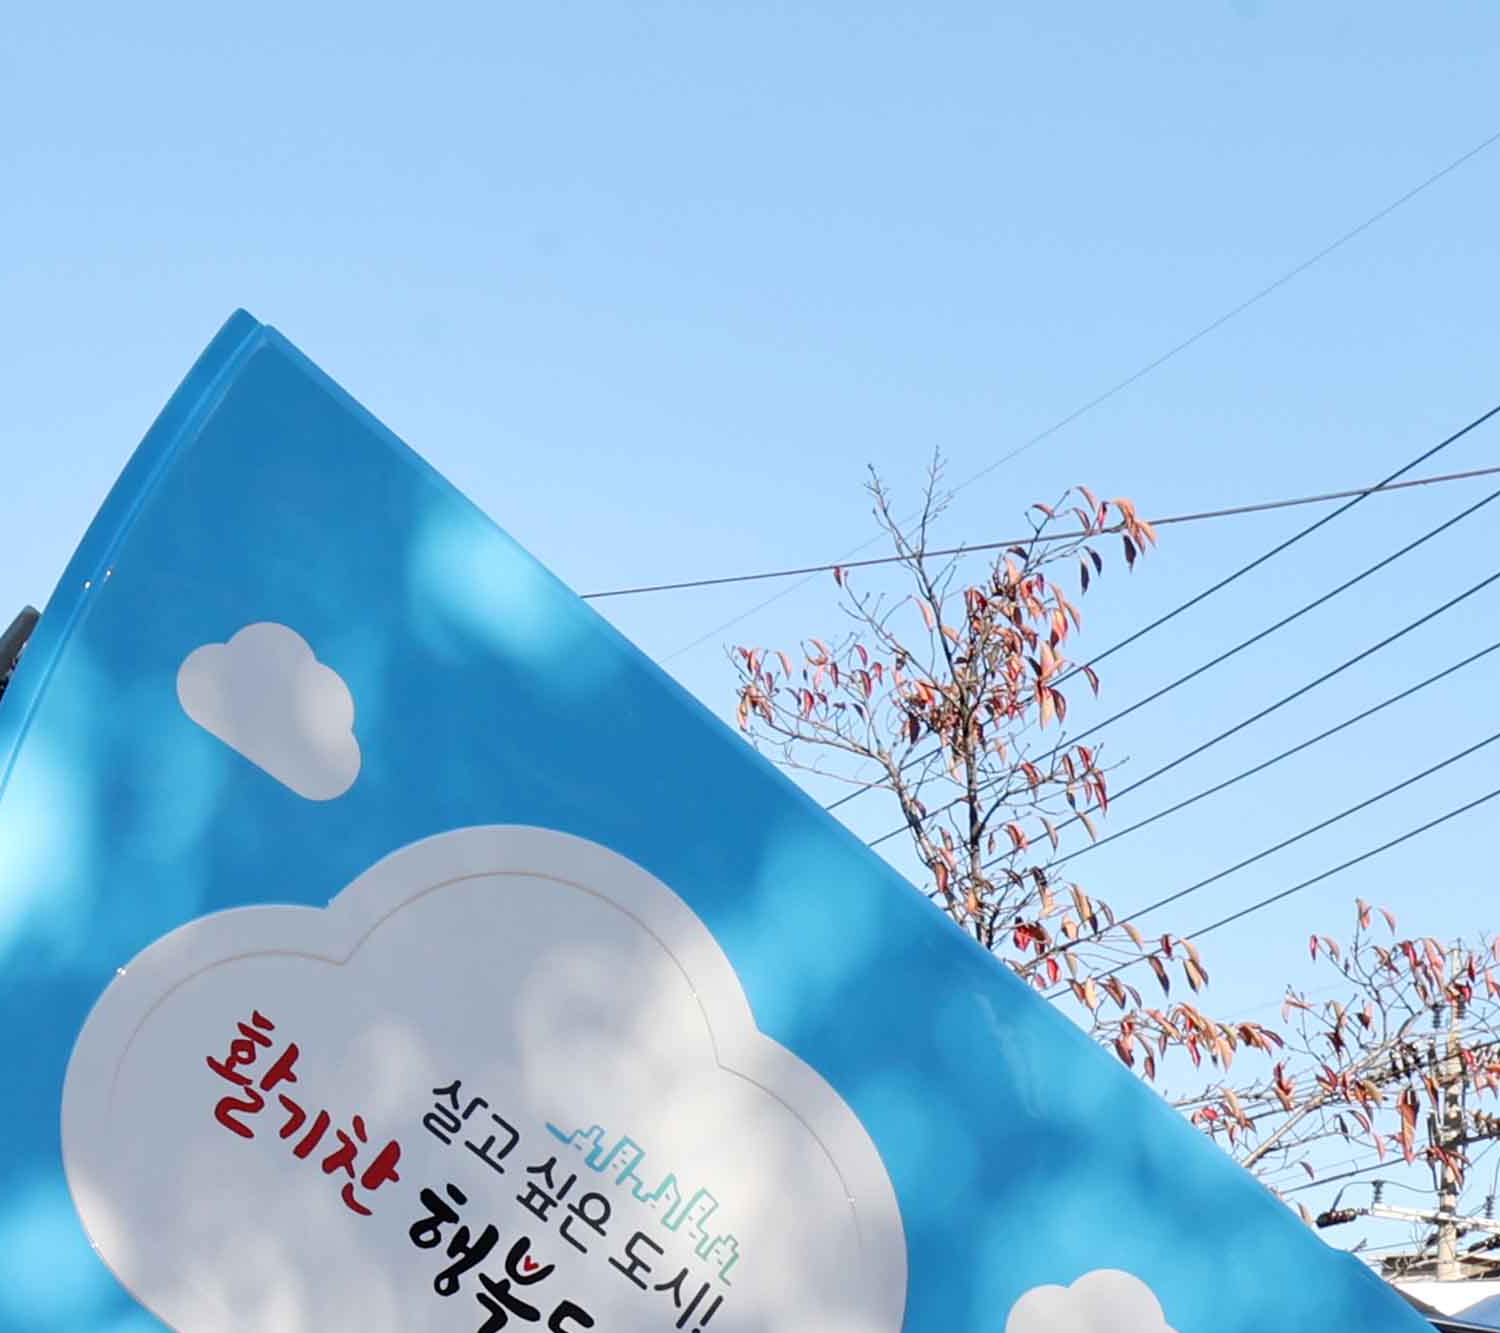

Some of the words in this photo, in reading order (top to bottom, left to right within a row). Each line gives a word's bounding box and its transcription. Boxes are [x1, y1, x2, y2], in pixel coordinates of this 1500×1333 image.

[207, 1010, 402, 1217] 활기찬
[422, 1078, 518, 1163] 살고
[516, 1158, 611, 1251] 싶은
